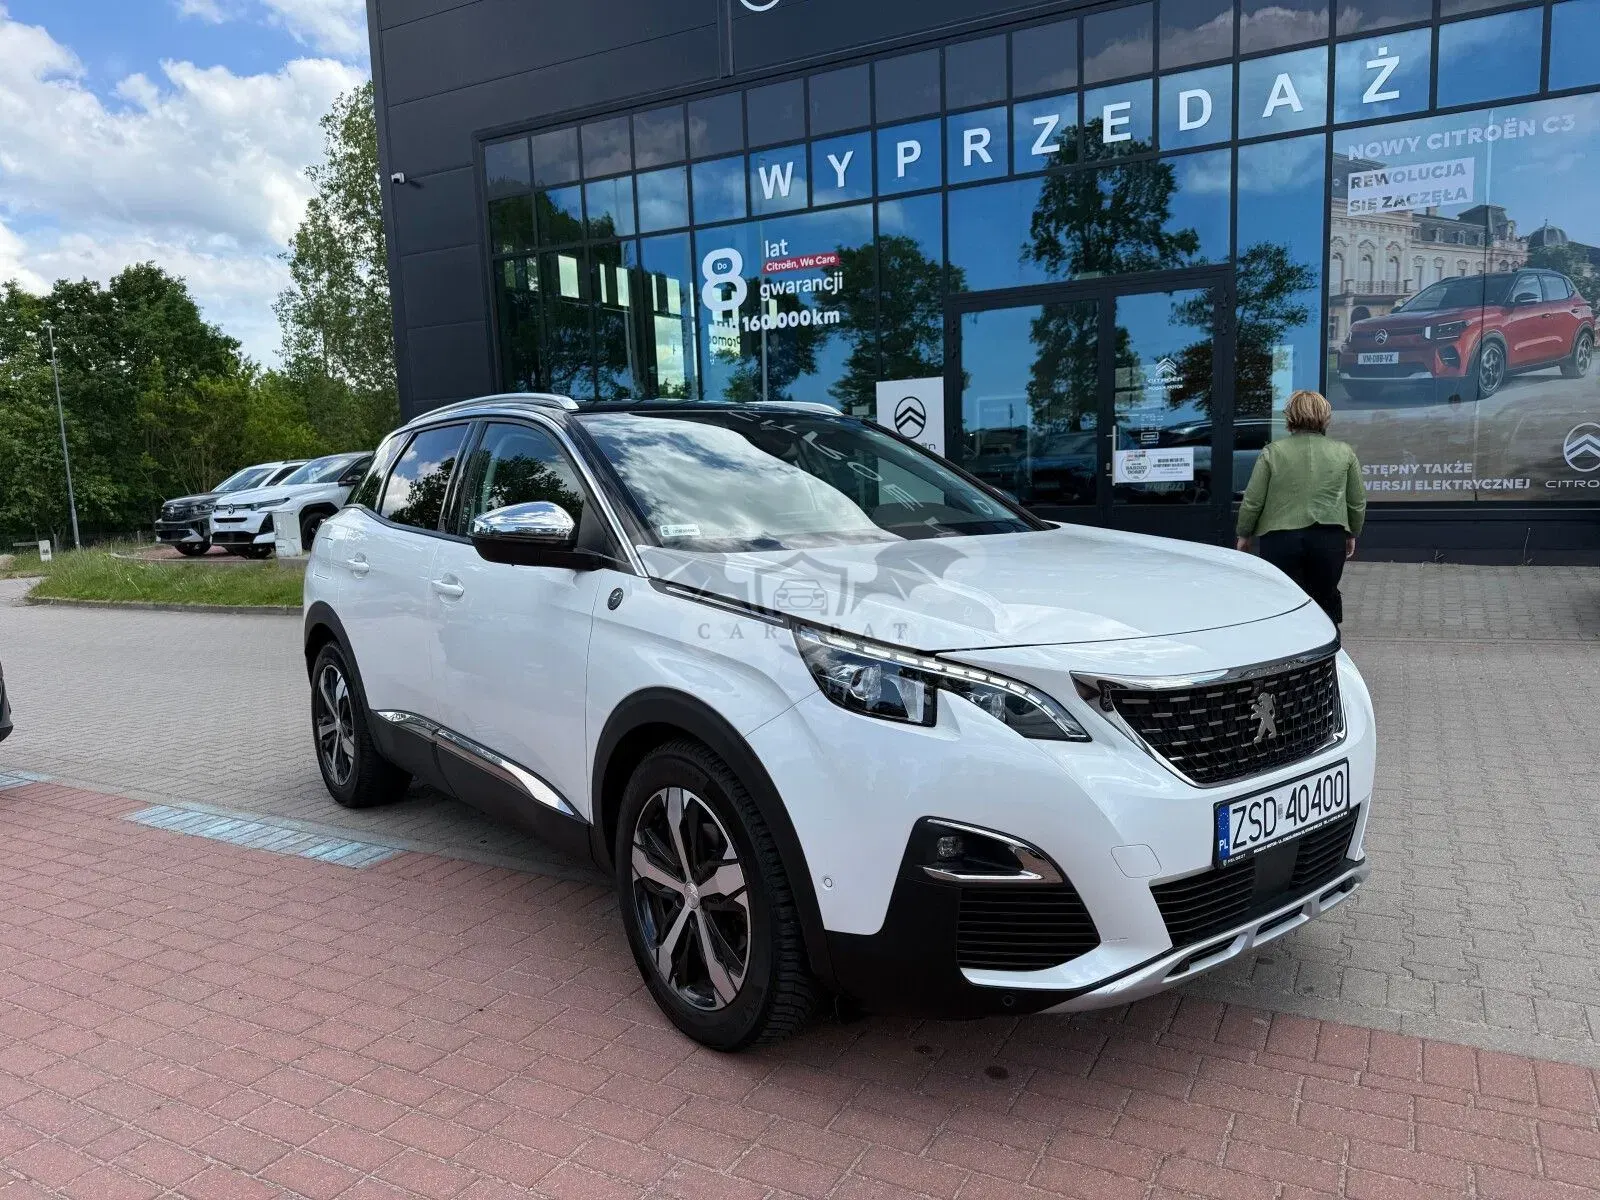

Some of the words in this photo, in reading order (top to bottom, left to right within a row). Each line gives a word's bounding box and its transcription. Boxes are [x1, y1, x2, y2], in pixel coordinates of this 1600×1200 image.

[1349, 135, 1421, 161] NOWY
[1426, 117, 1536, 150] CITROËN
[1542, 113, 1576, 133] C3
[1350, 163, 1466, 189] REWOLUCJA
[1381, 187, 1468, 209] ZACZĘŁA
[765, 239, 788, 258] lat
[717, 262, 728, 271] Do
[766, 260, 799, 272] Citroën,
[800, 258, 815, 267] We
[815, 255, 836, 265] Care
[702, 248, 747, 311] 8
[760, 271, 844, 301] gwarancji
[1422, 460, 1473, 474] TAKŻE
[1415, 478, 1531, 490] ELEKTRYCZNEJ
[1232, 796, 1277, 850] ZSD
[1285, 770, 1344, 827] 40400
[1218, 838, 1229, 851] PL
